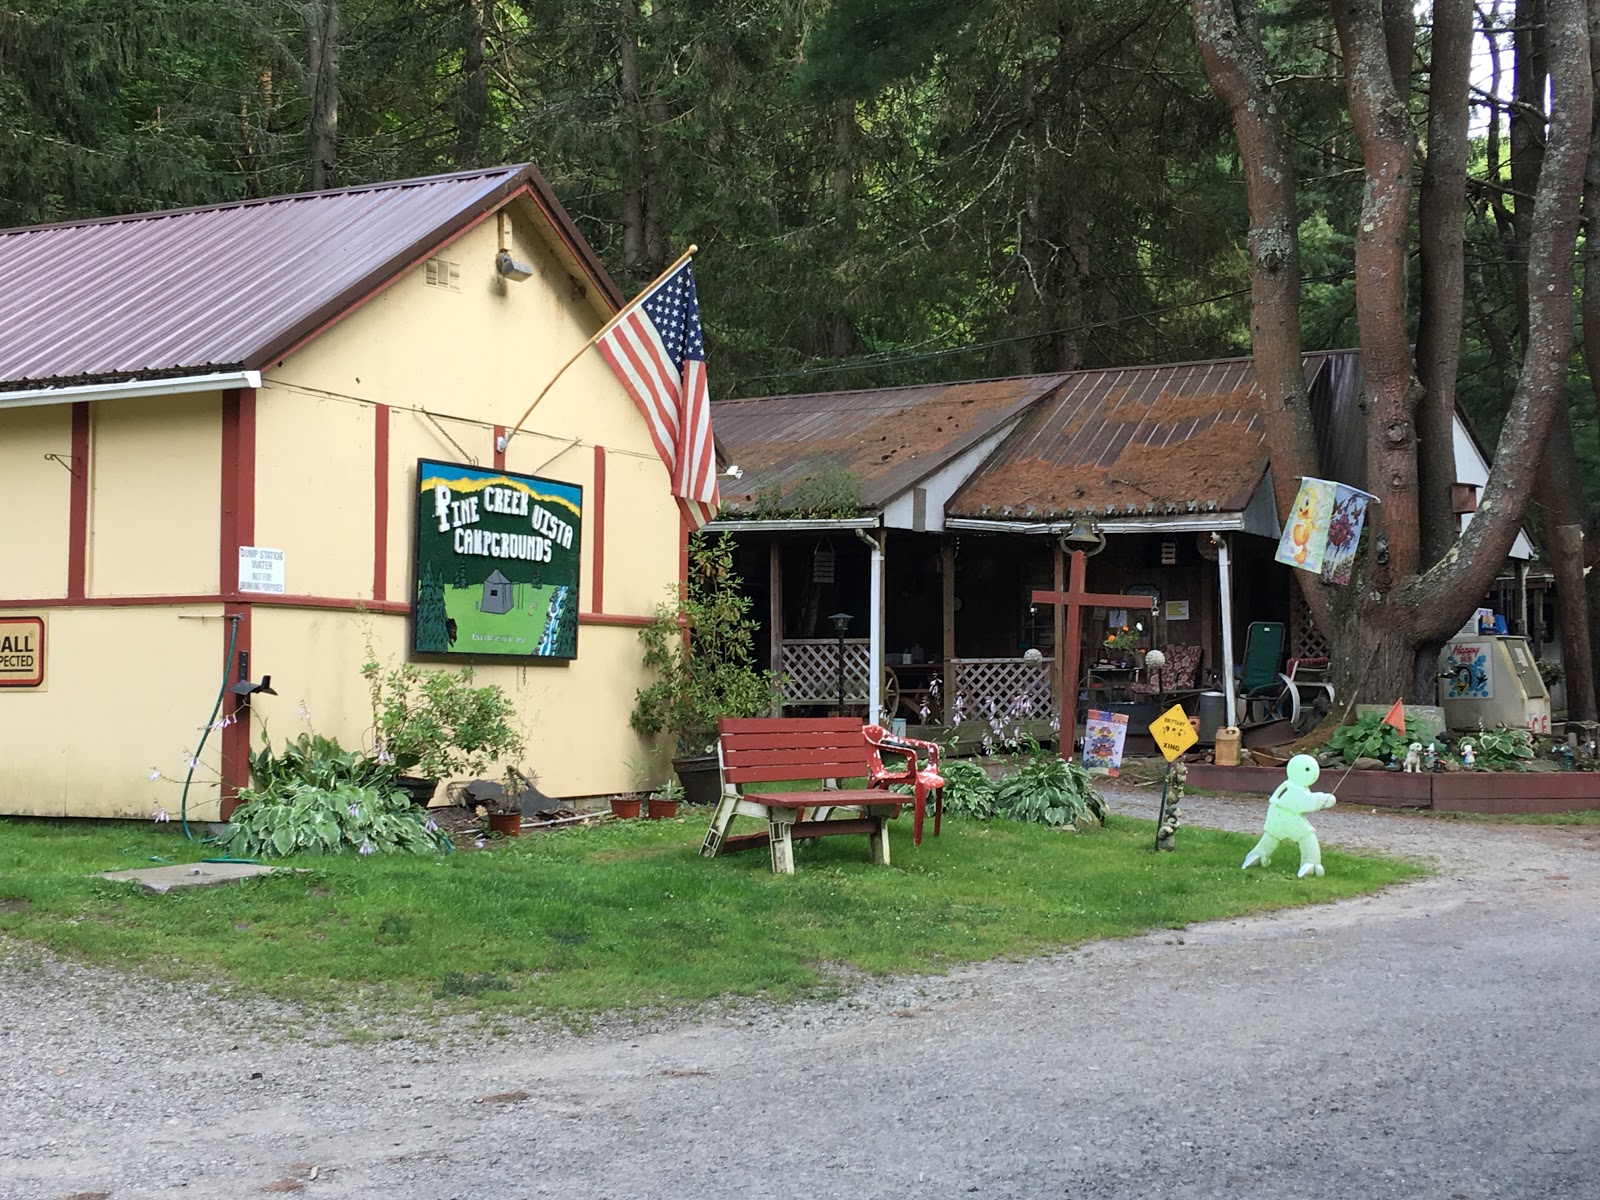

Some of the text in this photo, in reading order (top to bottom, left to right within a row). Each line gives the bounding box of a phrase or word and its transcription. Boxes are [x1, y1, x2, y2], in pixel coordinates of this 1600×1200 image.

[435, 485, 573, 550] PINE CREEK VISTA
[454, 528, 552, 563] CAMPGROUNDS
[241, 548, 283, 561] DUMP STATION
[252, 560, 272, 570] WATER
[1453, 644, 1480, 658] Happy
[1163, 742, 1180, 752] XING
